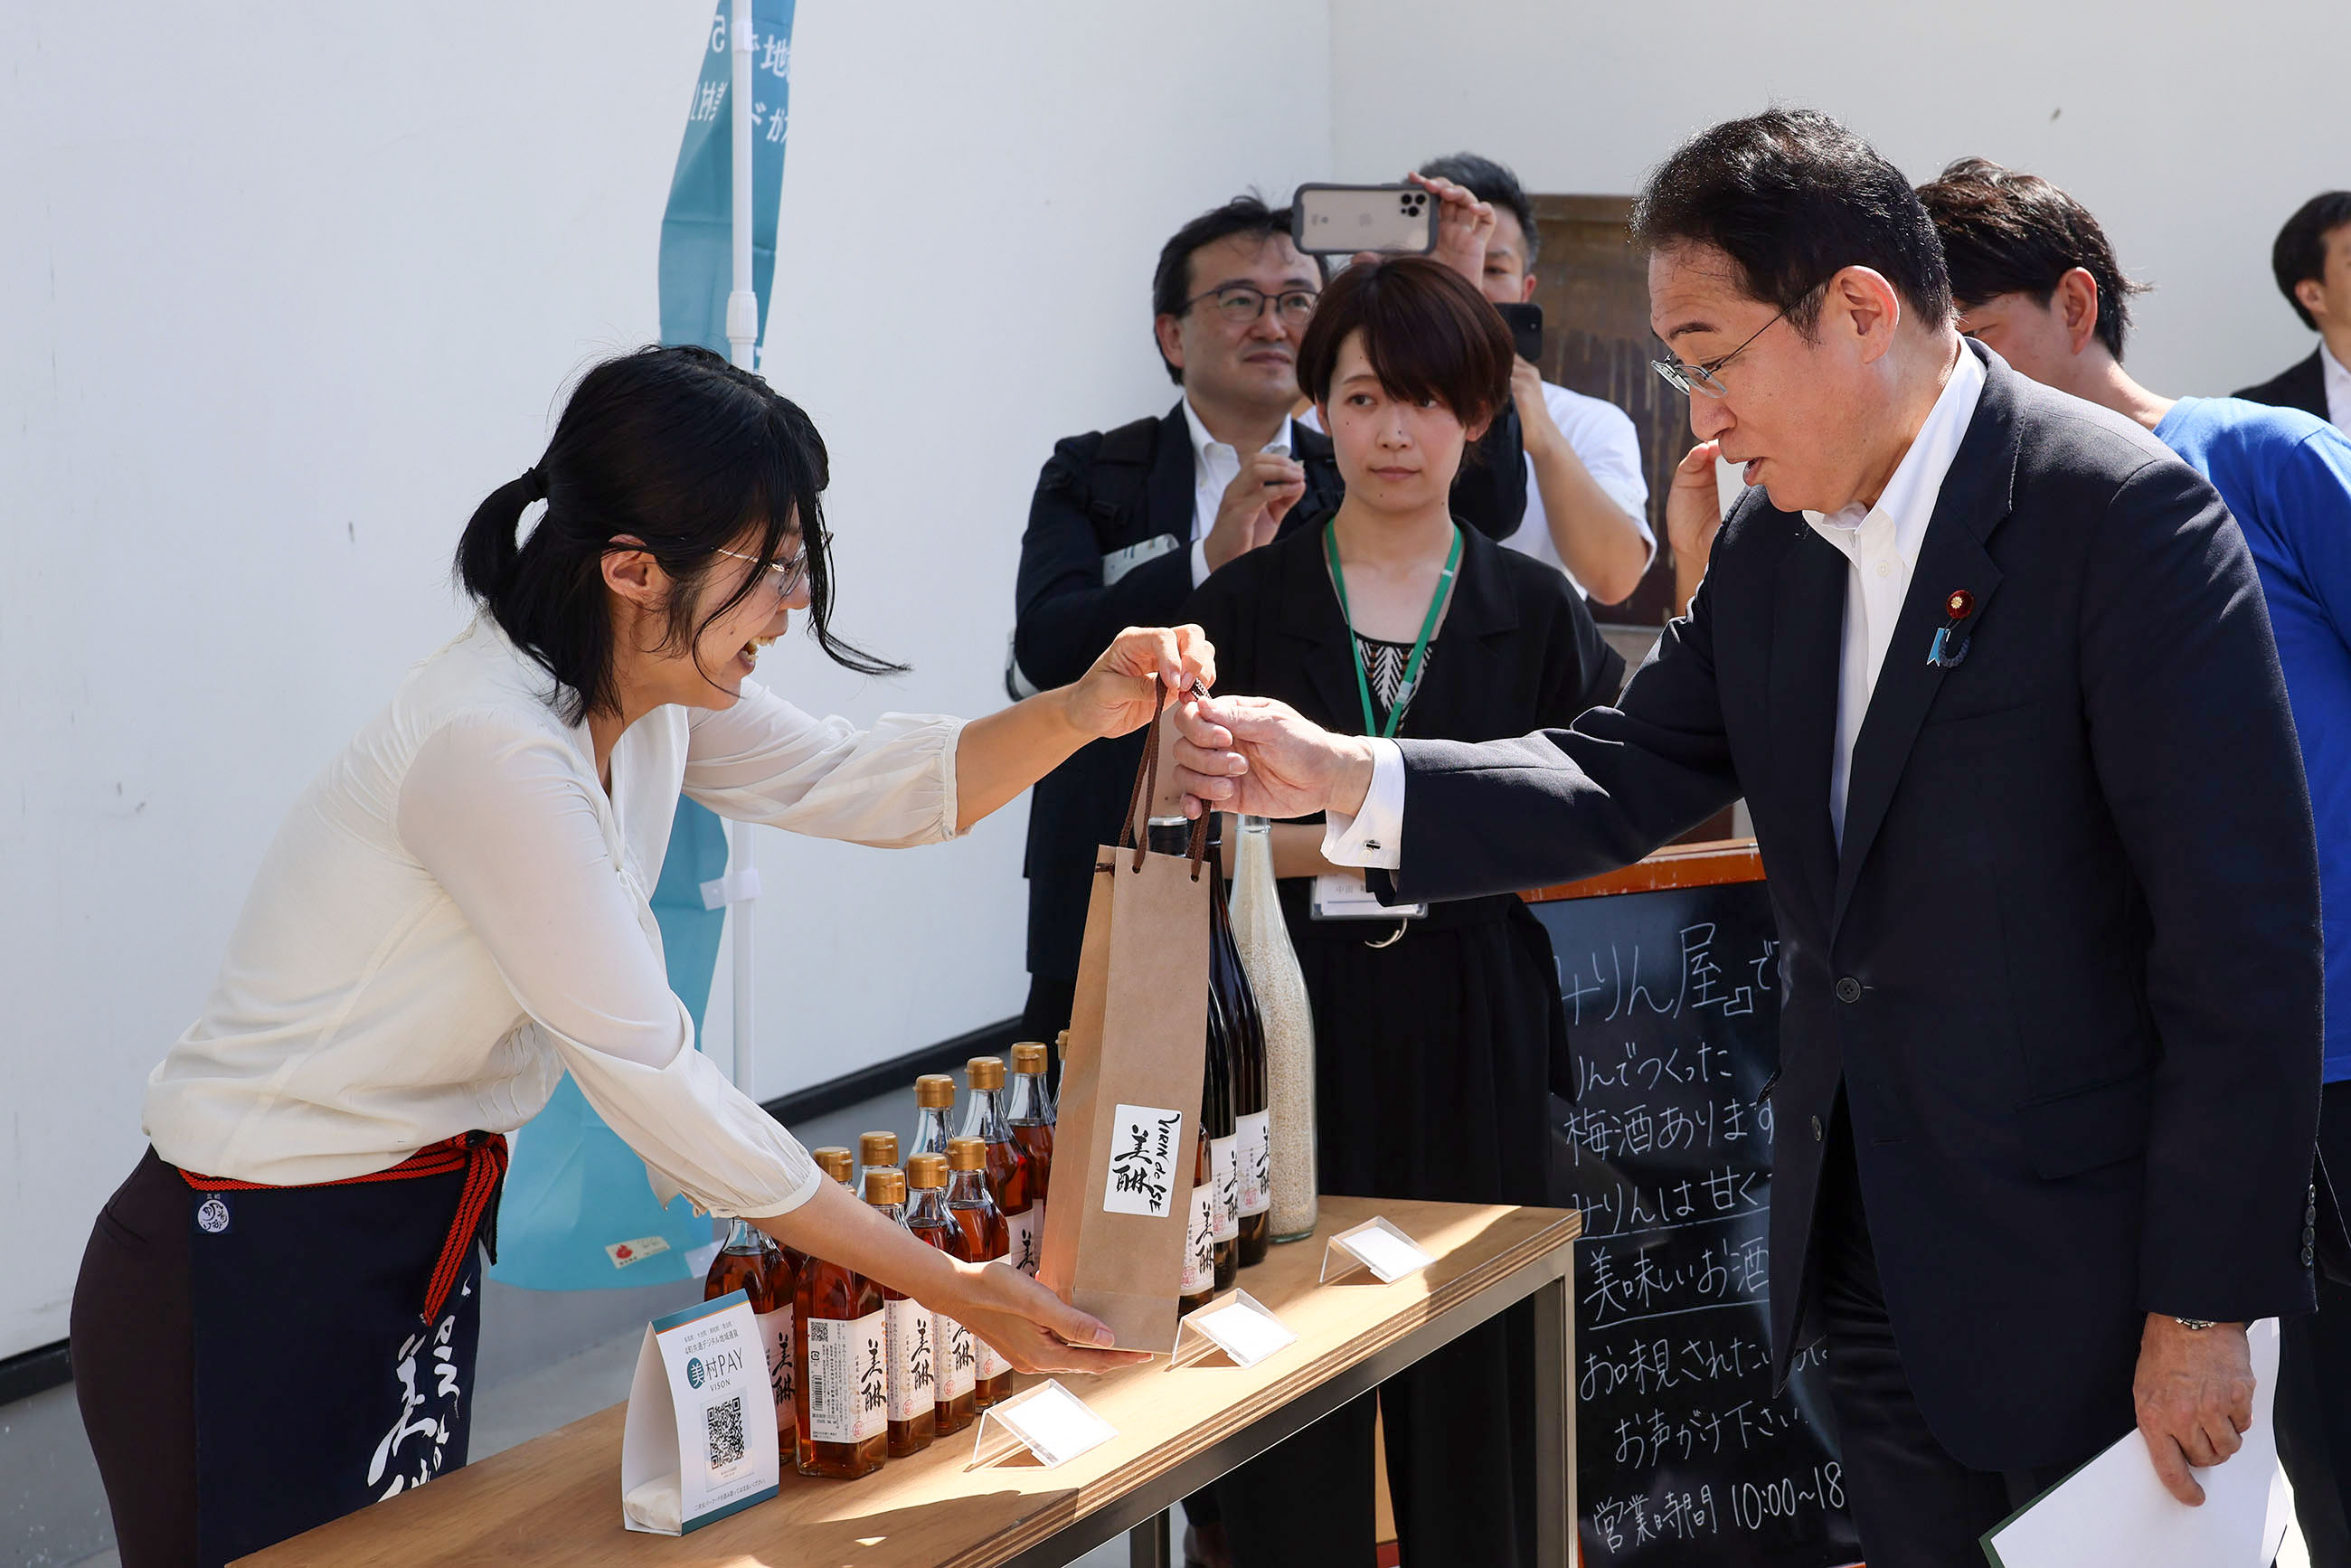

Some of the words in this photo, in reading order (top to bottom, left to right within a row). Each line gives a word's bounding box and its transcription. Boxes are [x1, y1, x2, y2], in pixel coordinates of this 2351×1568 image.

[710, 1378, 731, 1393] VISON
[1593, 1485, 1718, 1554] 営業時間
